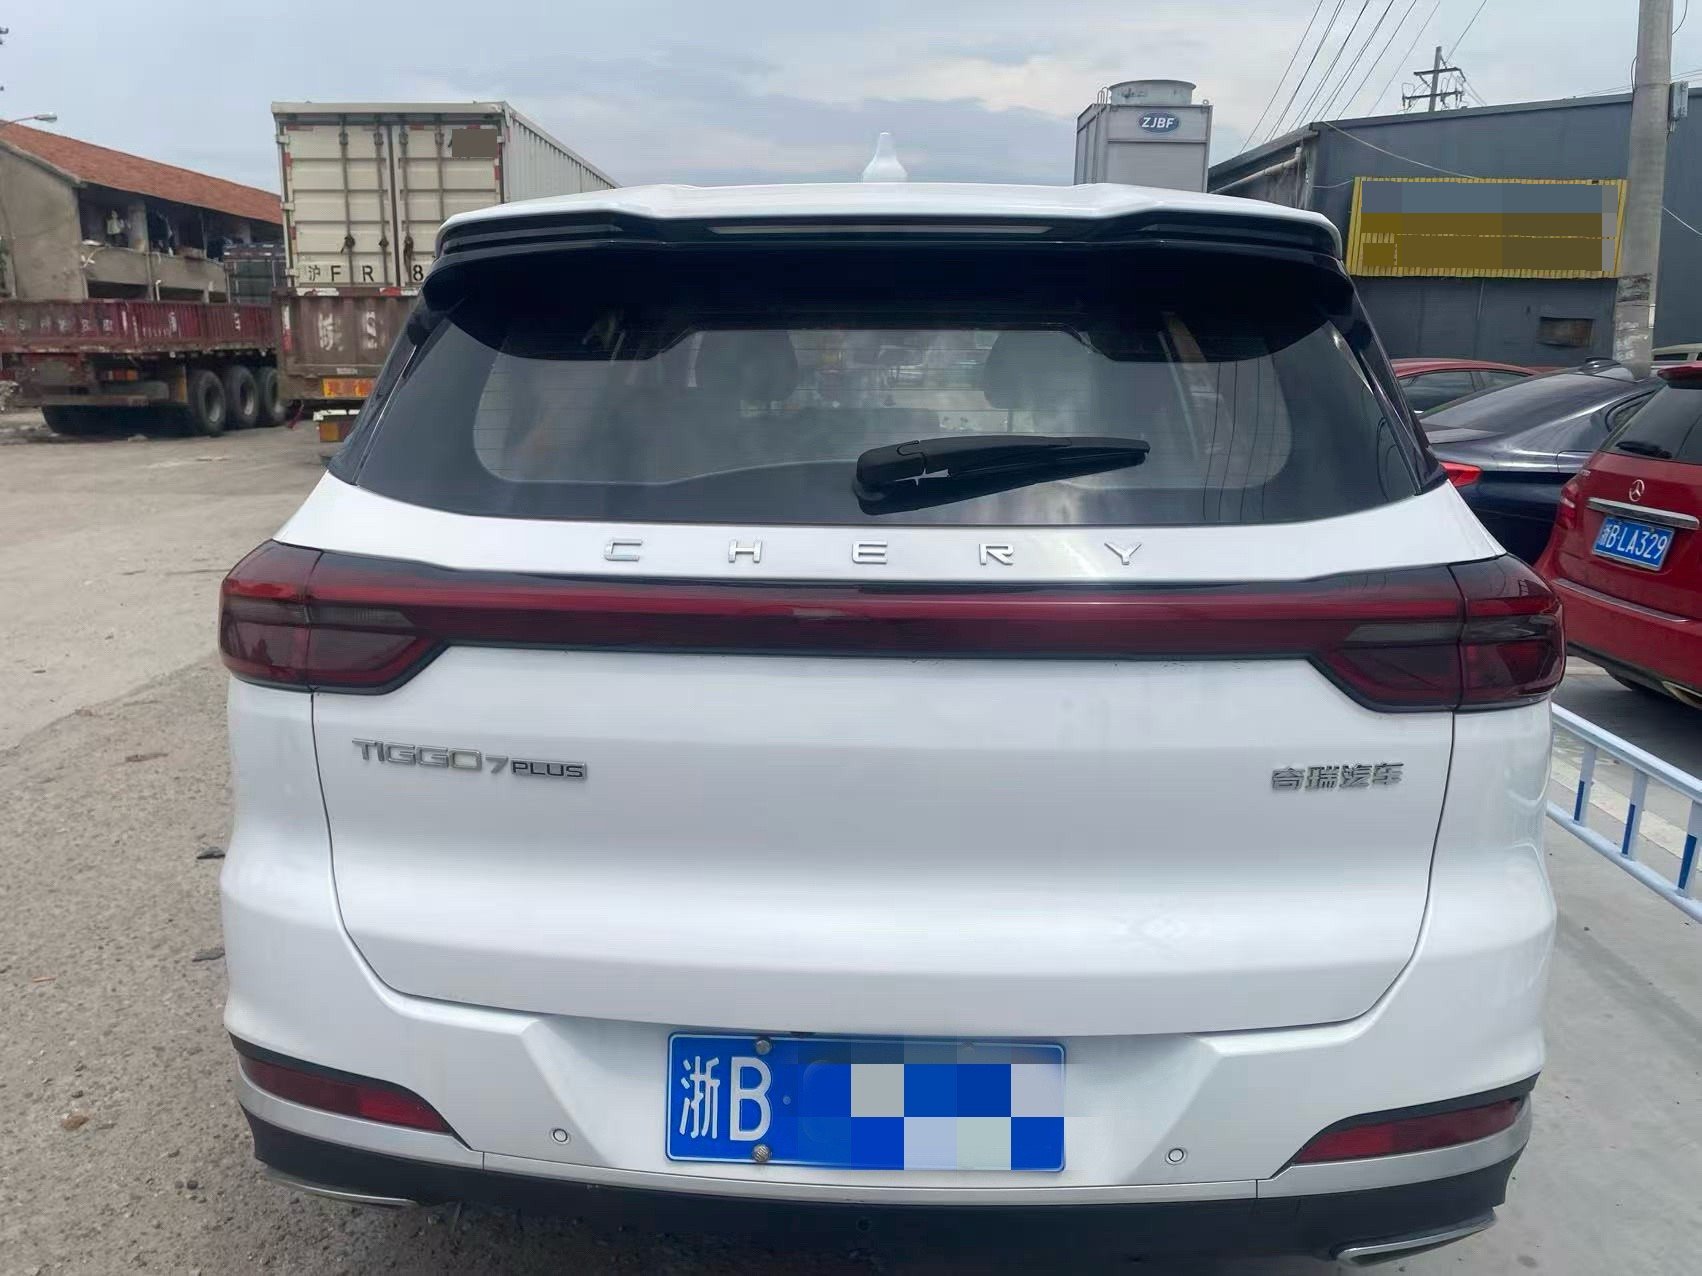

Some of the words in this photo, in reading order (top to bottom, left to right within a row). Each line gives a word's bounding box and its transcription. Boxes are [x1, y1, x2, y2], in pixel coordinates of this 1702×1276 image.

[1141, 117, 1175, 129] ZJBF
[603, 539, 1143, 567] CHERY
[511, 759, 586, 780] PLUS
[1271, 763, 1404, 791] 奇瑞汽车
